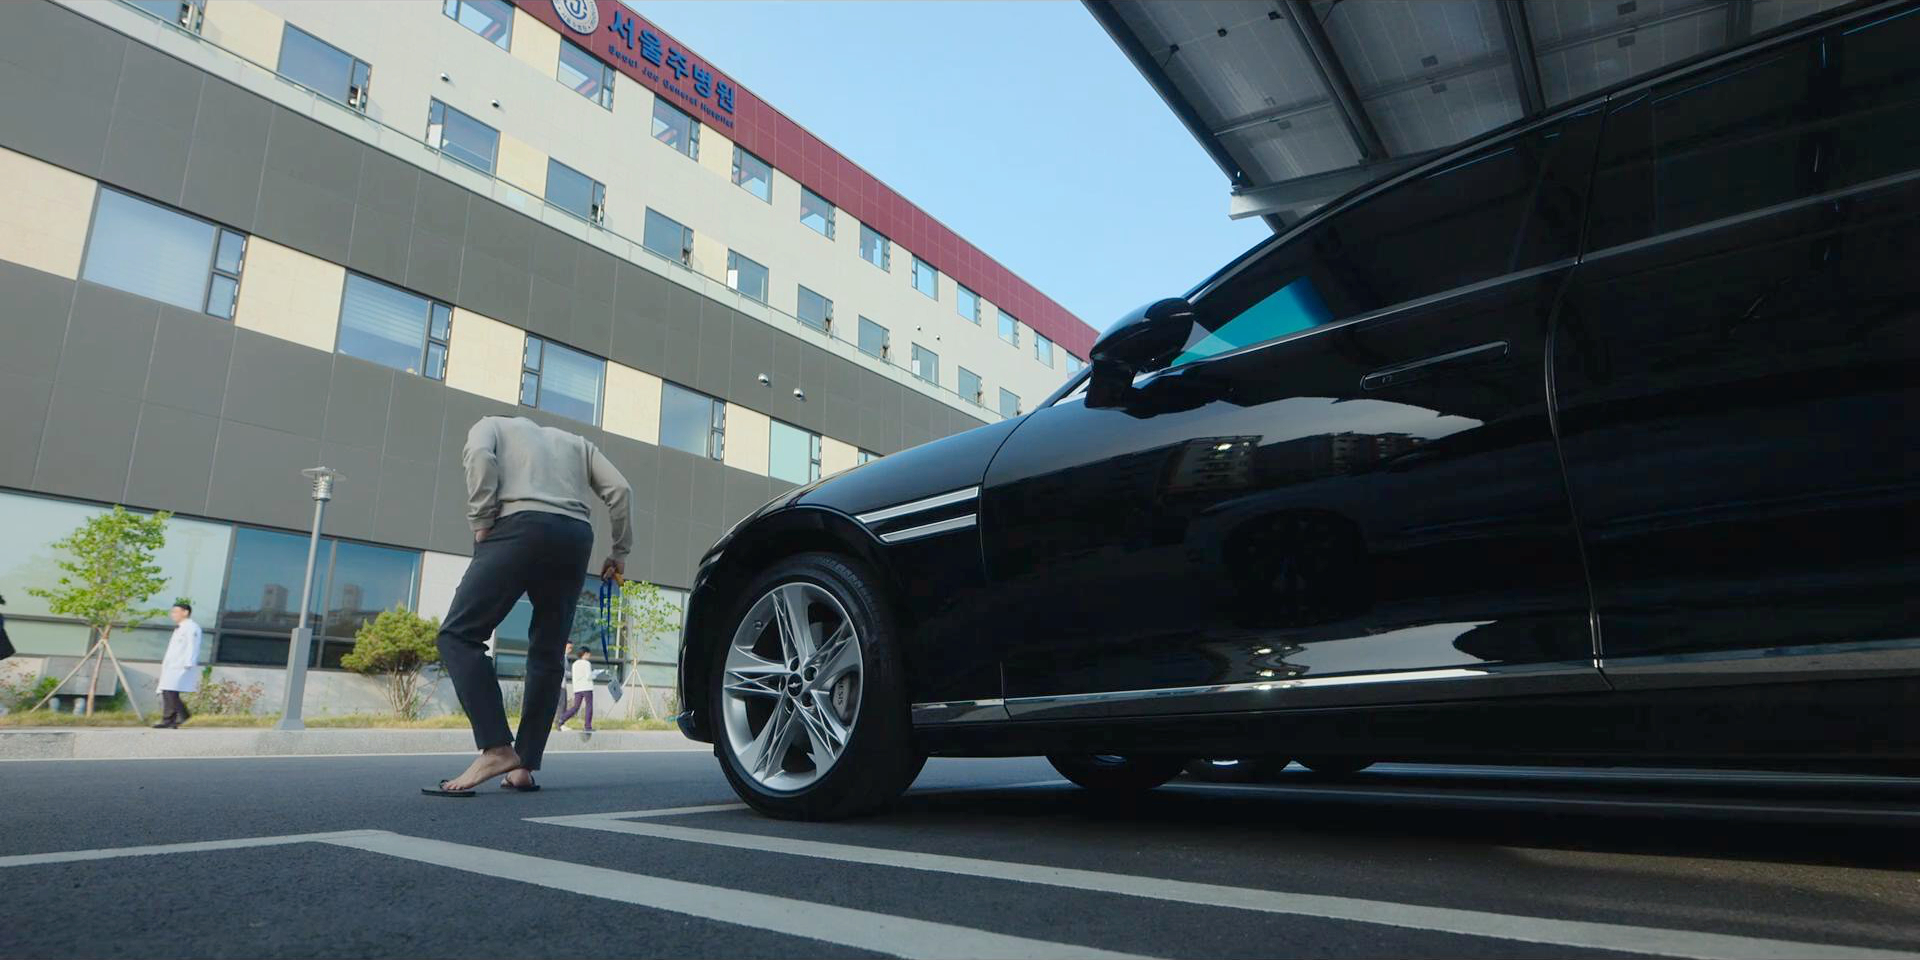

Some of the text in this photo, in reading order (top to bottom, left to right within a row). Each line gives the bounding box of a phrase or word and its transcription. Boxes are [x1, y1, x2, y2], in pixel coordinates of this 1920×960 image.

[608, 10, 735, 114] 서울주병원
[608, 44, 638, 68] Seoul
[700, 102, 734, 129] Hospital
